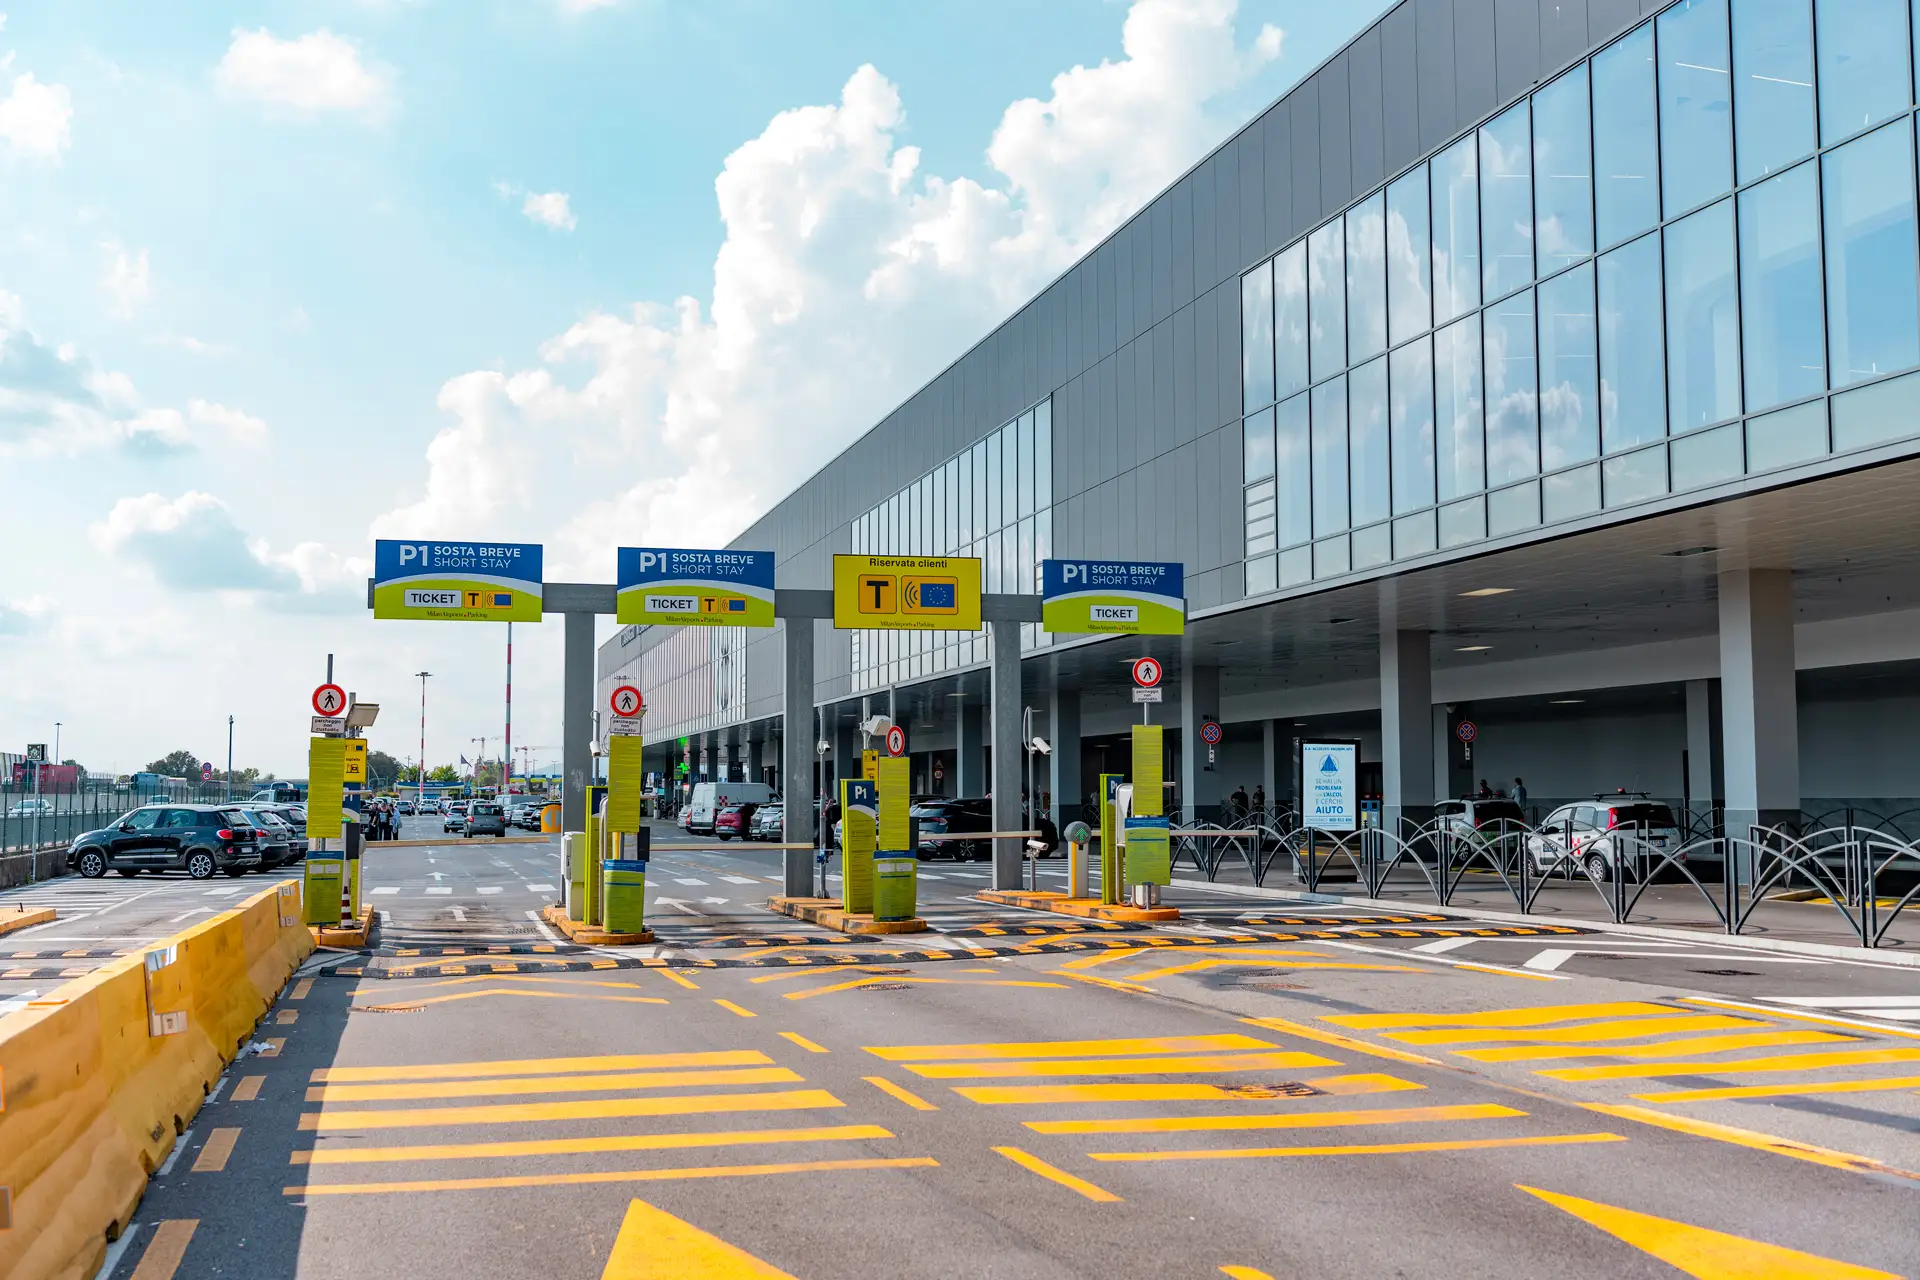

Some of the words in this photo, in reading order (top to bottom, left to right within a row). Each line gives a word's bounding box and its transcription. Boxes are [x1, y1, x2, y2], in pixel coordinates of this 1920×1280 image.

[400, 544, 428, 567] P1
[434, 546, 475, 556] SOSTA
[480, 547, 521, 558] BREVE
[434, 557, 477, 568] SHORT
[481, 558, 511, 569] STAY
[640, 552, 667, 573] P1
[672, 553, 711, 563] SOSTA
[715, 554, 754, 565] BREVE
[869, 558, 916, 567] Riservata
[918, 559, 947, 568] clienti
[672, 564, 712, 574] SHORT
[716, 565, 744, 575] STAY
[1063, 564, 1087, 584] P1
[1092, 565, 1127, 575] SOSTA
[1130, 566, 1166, 576] BREVE
[1092, 575, 1129, 585] SHORT
[1131, 576, 1158, 586] STAY
[411, 593, 456, 604] TICKET
[468, 592, 480, 607] T
[866, 580, 889, 609] T
[651, 599, 693, 609] TICKET
[704, 598, 716, 612] T
[1096, 609, 1133, 618] TICKET
[855, 786, 867, 799] P1
[1315, 806, 1344, 814] AIUTO
